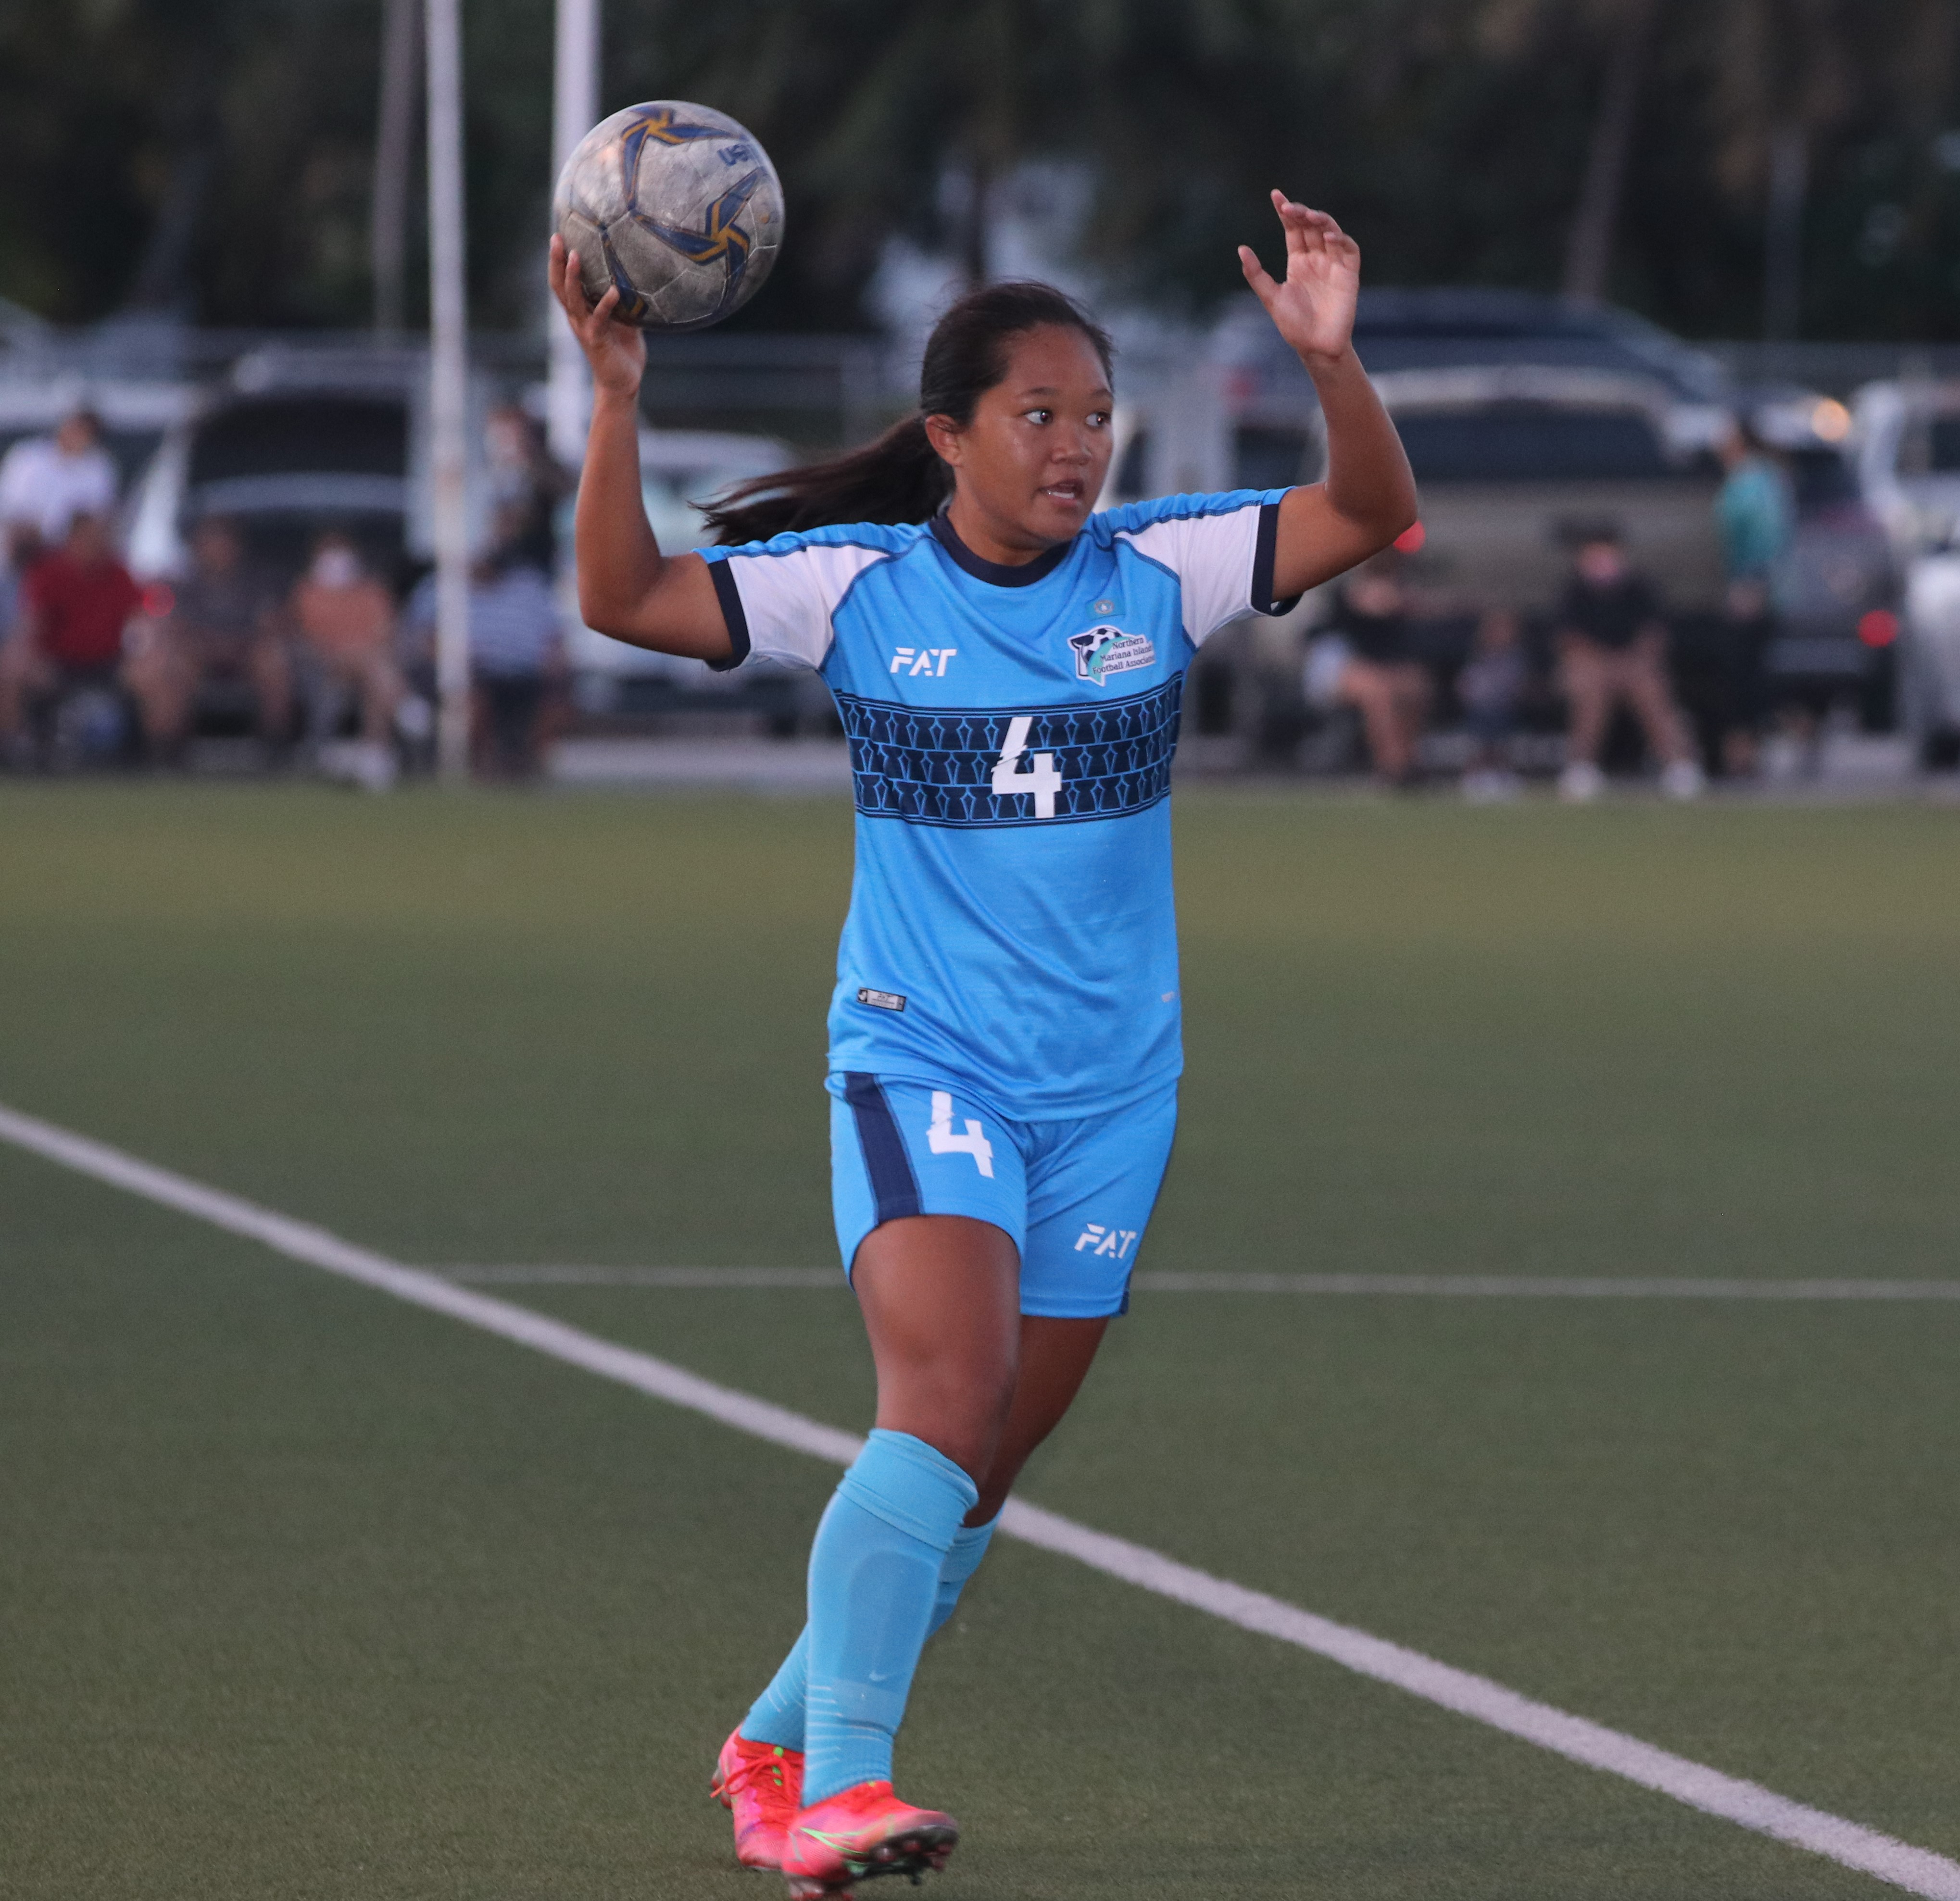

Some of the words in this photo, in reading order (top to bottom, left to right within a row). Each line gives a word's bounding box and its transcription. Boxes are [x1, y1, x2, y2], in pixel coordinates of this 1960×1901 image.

[1100, 651, 1131, 662] Mariana
[1132, 644, 1152, 655] Island
[1112, 638, 1144, 649] Northern
[890, 647, 957, 677] FAT
[1093, 662, 1124, 674] Football
[991, 716, 1062, 819] 4
[926, 1090, 994, 1179] 4
[1074, 1223, 1137, 1259] FAT
